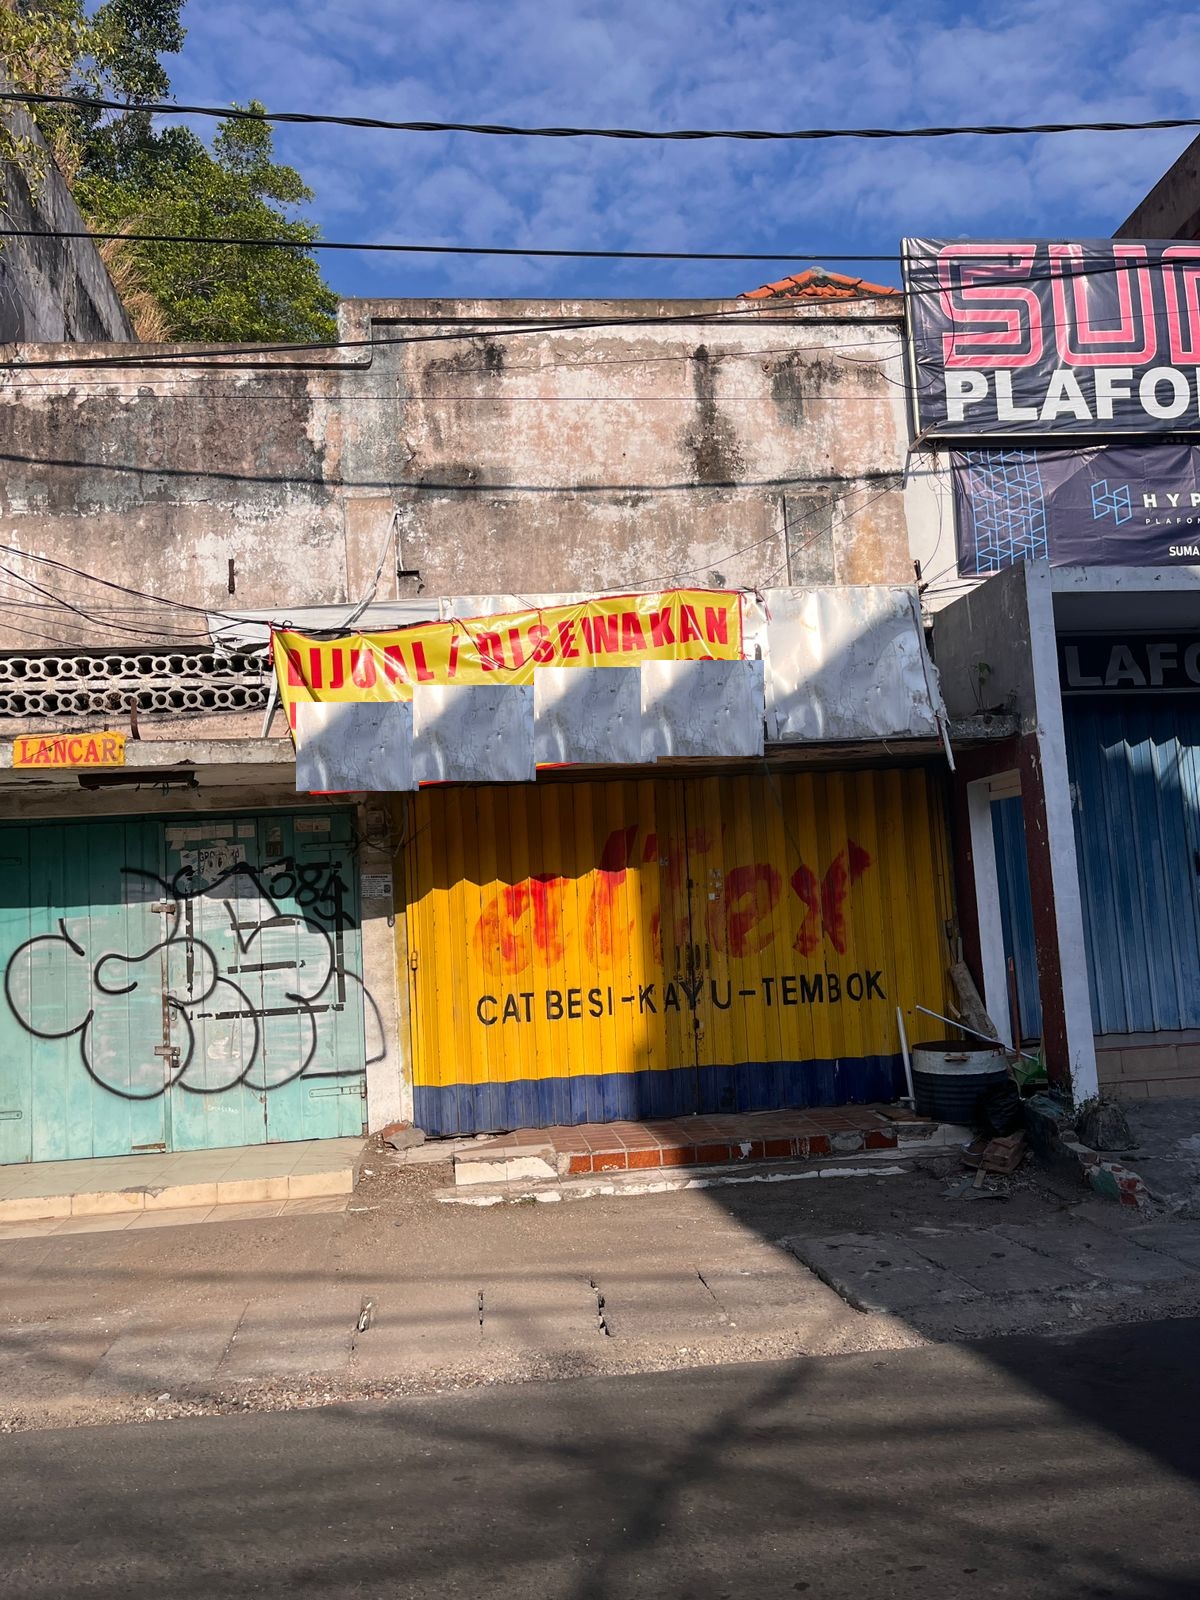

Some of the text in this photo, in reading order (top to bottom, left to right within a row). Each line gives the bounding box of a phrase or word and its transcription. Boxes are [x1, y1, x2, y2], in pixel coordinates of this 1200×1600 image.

[944, 366, 1200, 422] PLAFO
[1169, 545, 1200, 556] SUMA
[287, 641, 435, 689] DIJUAL
[481, 604, 728, 672] DISEWAKAN
[20, 738, 119, 763] LANCAR
[477, 992, 535, 1026] CAT
